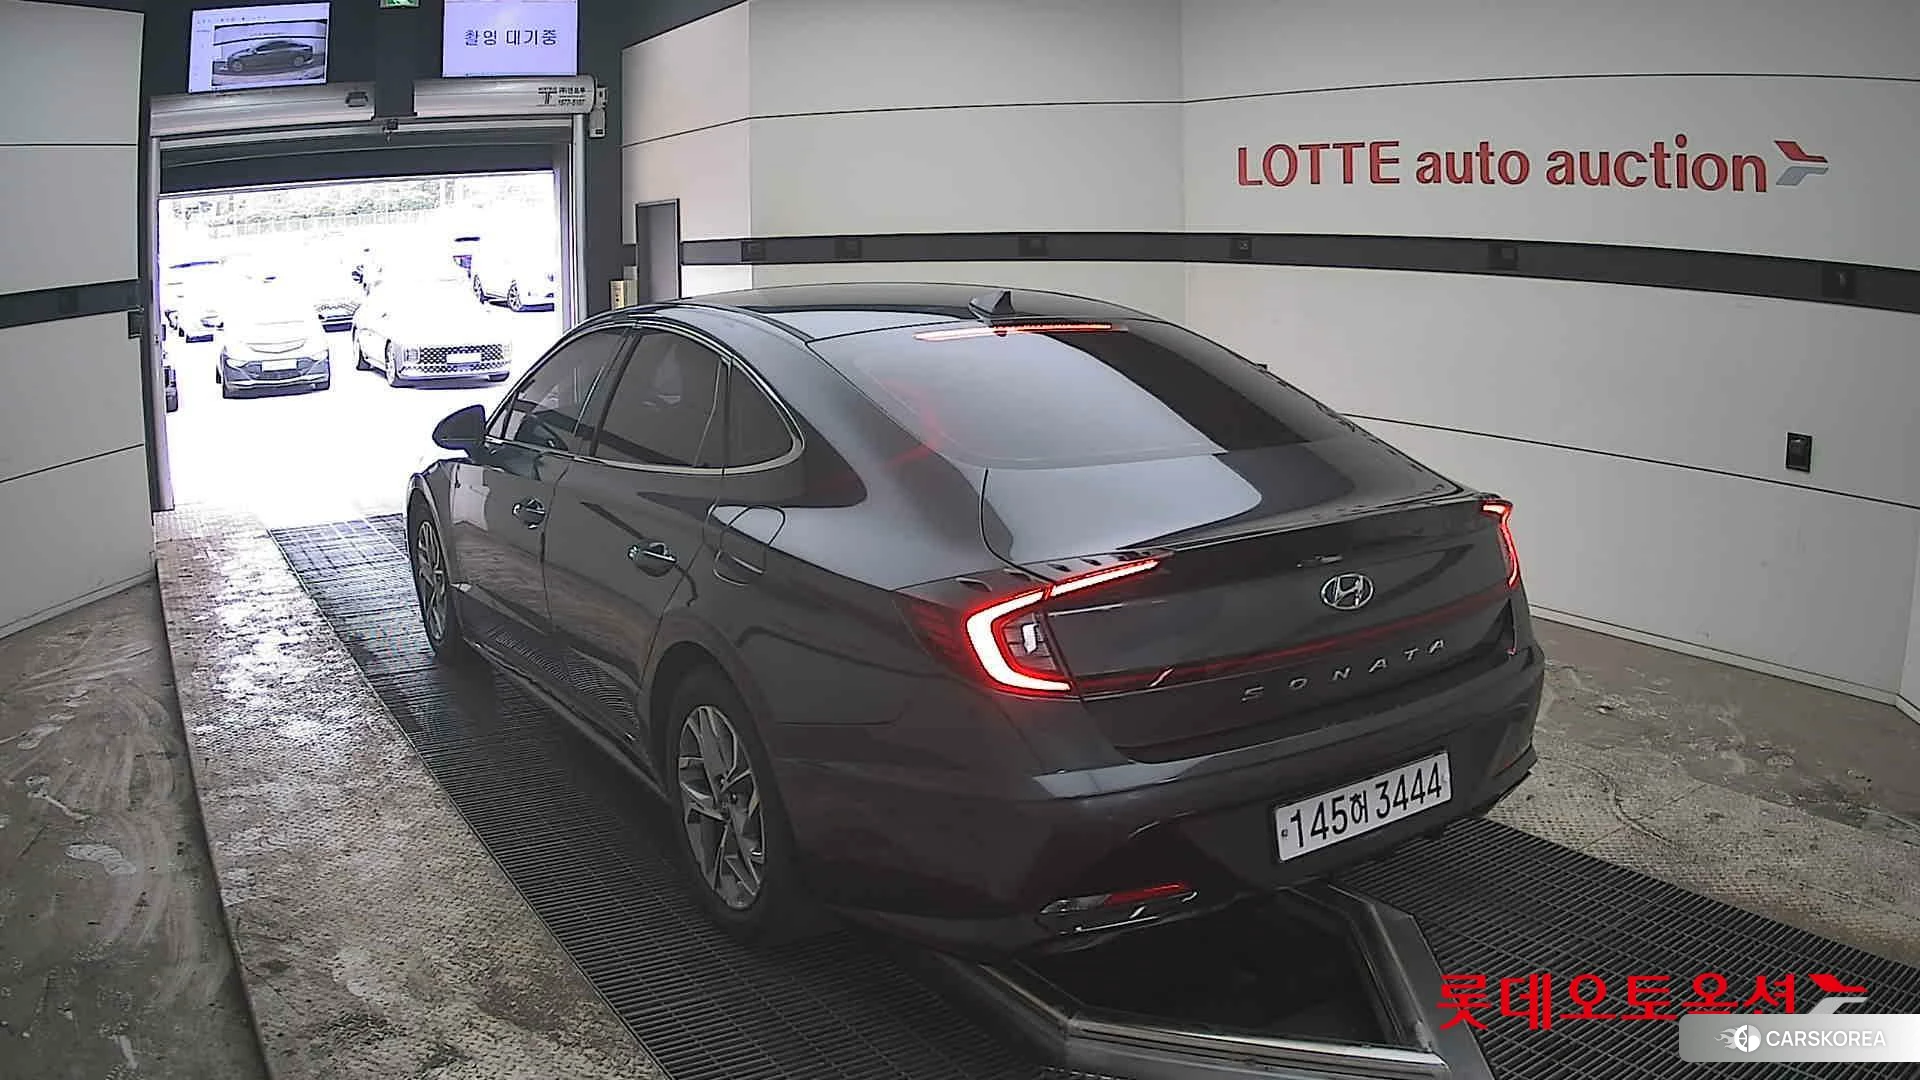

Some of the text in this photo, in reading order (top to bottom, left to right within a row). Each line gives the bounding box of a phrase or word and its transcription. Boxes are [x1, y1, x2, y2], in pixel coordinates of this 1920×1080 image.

[506, 29, 557, 46] 대기중
[1238, 133, 1767, 192] LOTTE auto auction
[1241, 639, 1444, 702] SONATA
[1290, 762, 1442, 849] 145허 3444
